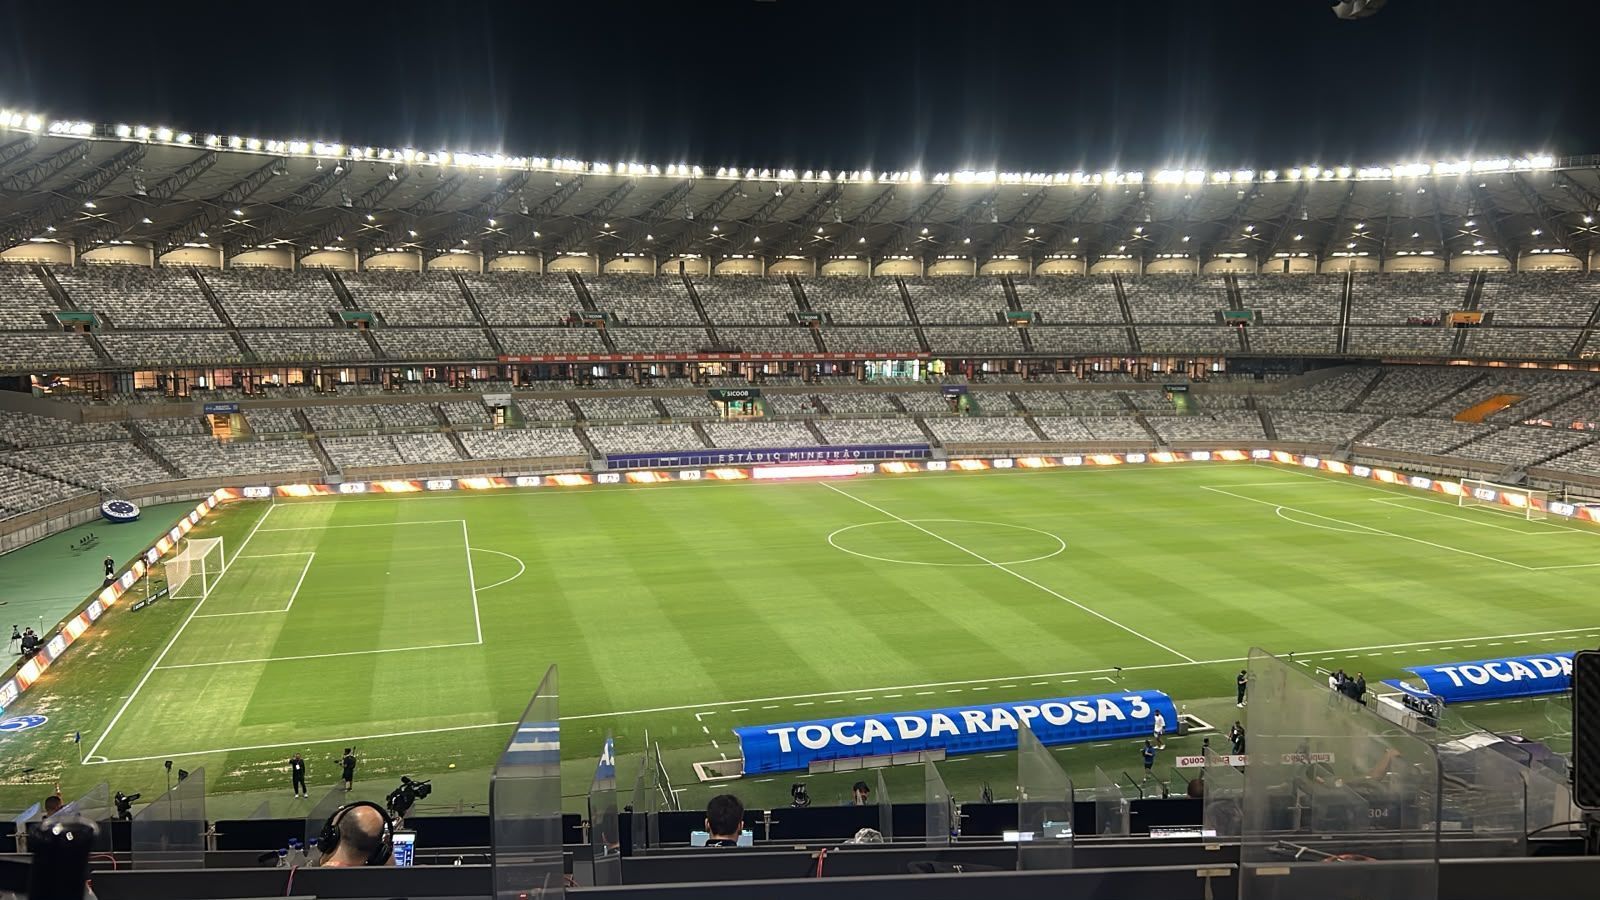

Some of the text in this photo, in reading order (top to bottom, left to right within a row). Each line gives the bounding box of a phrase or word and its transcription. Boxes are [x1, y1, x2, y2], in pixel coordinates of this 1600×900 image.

[719, 449, 860, 462] ESTÁDIO MINEIRÃO
[1436, 661, 1537, 687] TOCA
[767, 696, 1151, 753] TOCA DA RAPOSA 3
[1367, 808, 1389, 818] 304
